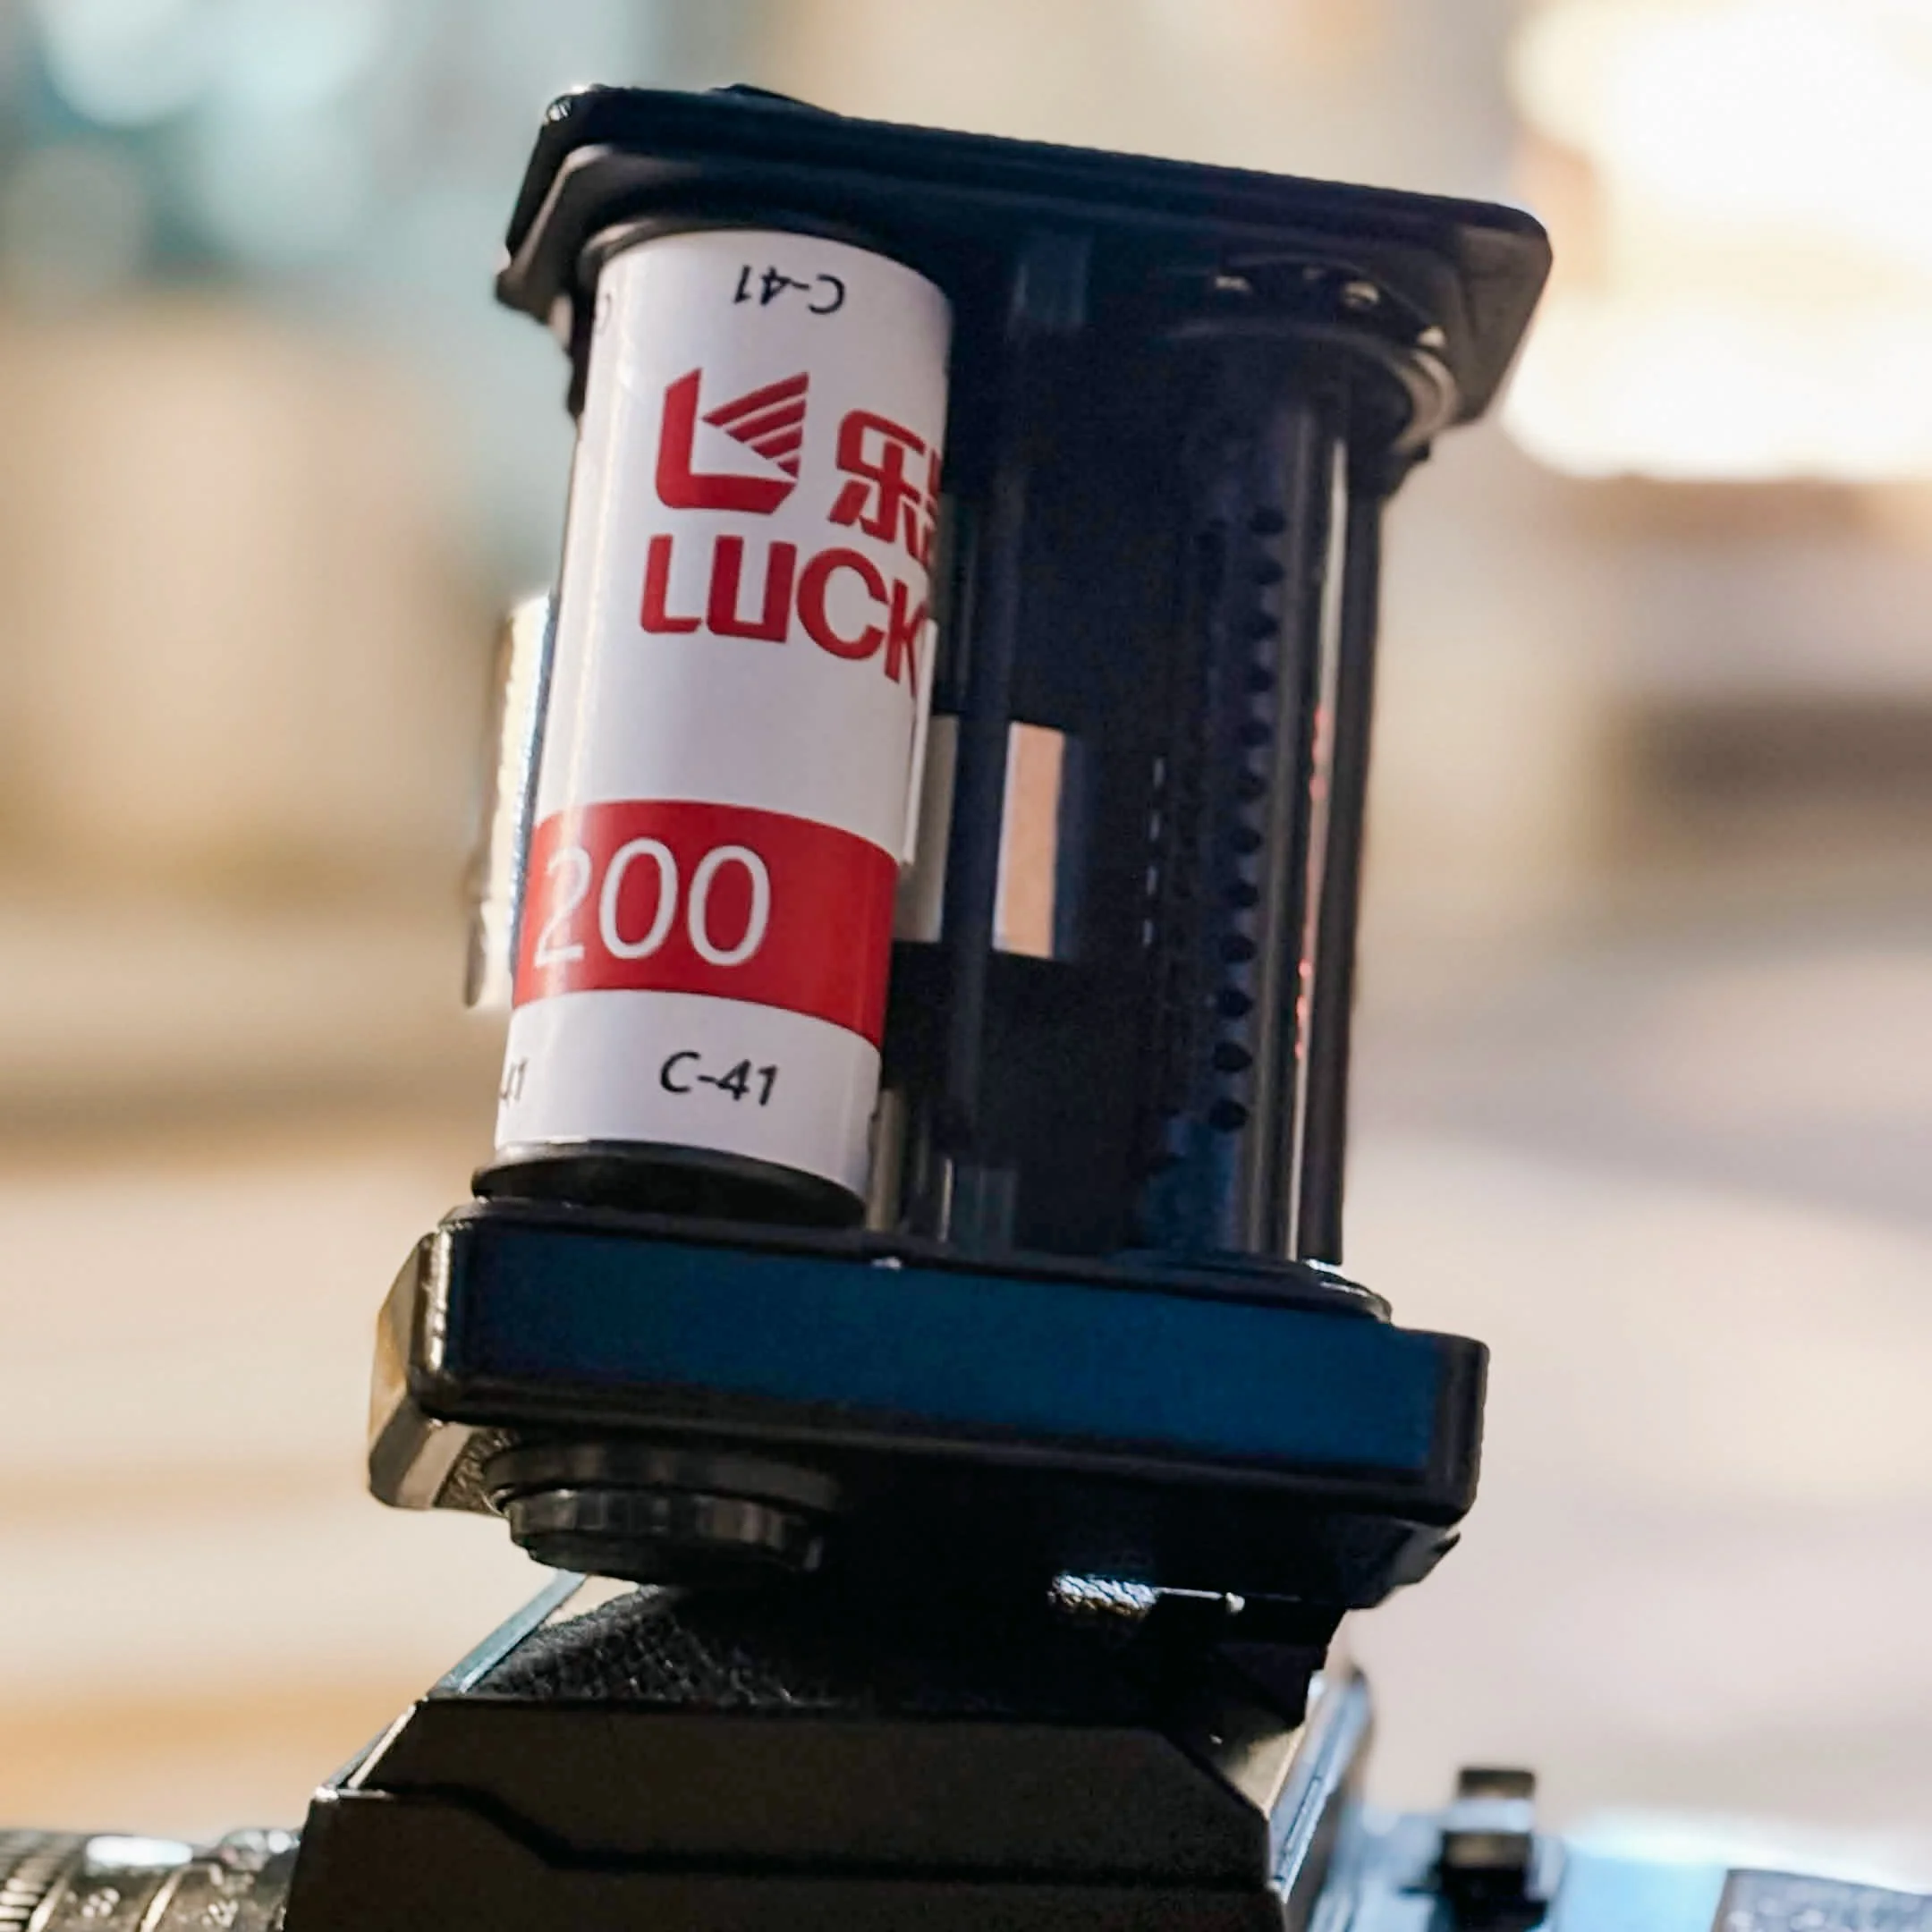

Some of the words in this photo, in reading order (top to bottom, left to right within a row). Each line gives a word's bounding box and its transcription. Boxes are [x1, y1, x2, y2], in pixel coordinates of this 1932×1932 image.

[733, 265, 845, 315] C-41
[828, 409, 942, 567] 乐
[534, 838, 771, 967] 200
[659, 1051, 779, 1106] C-41
